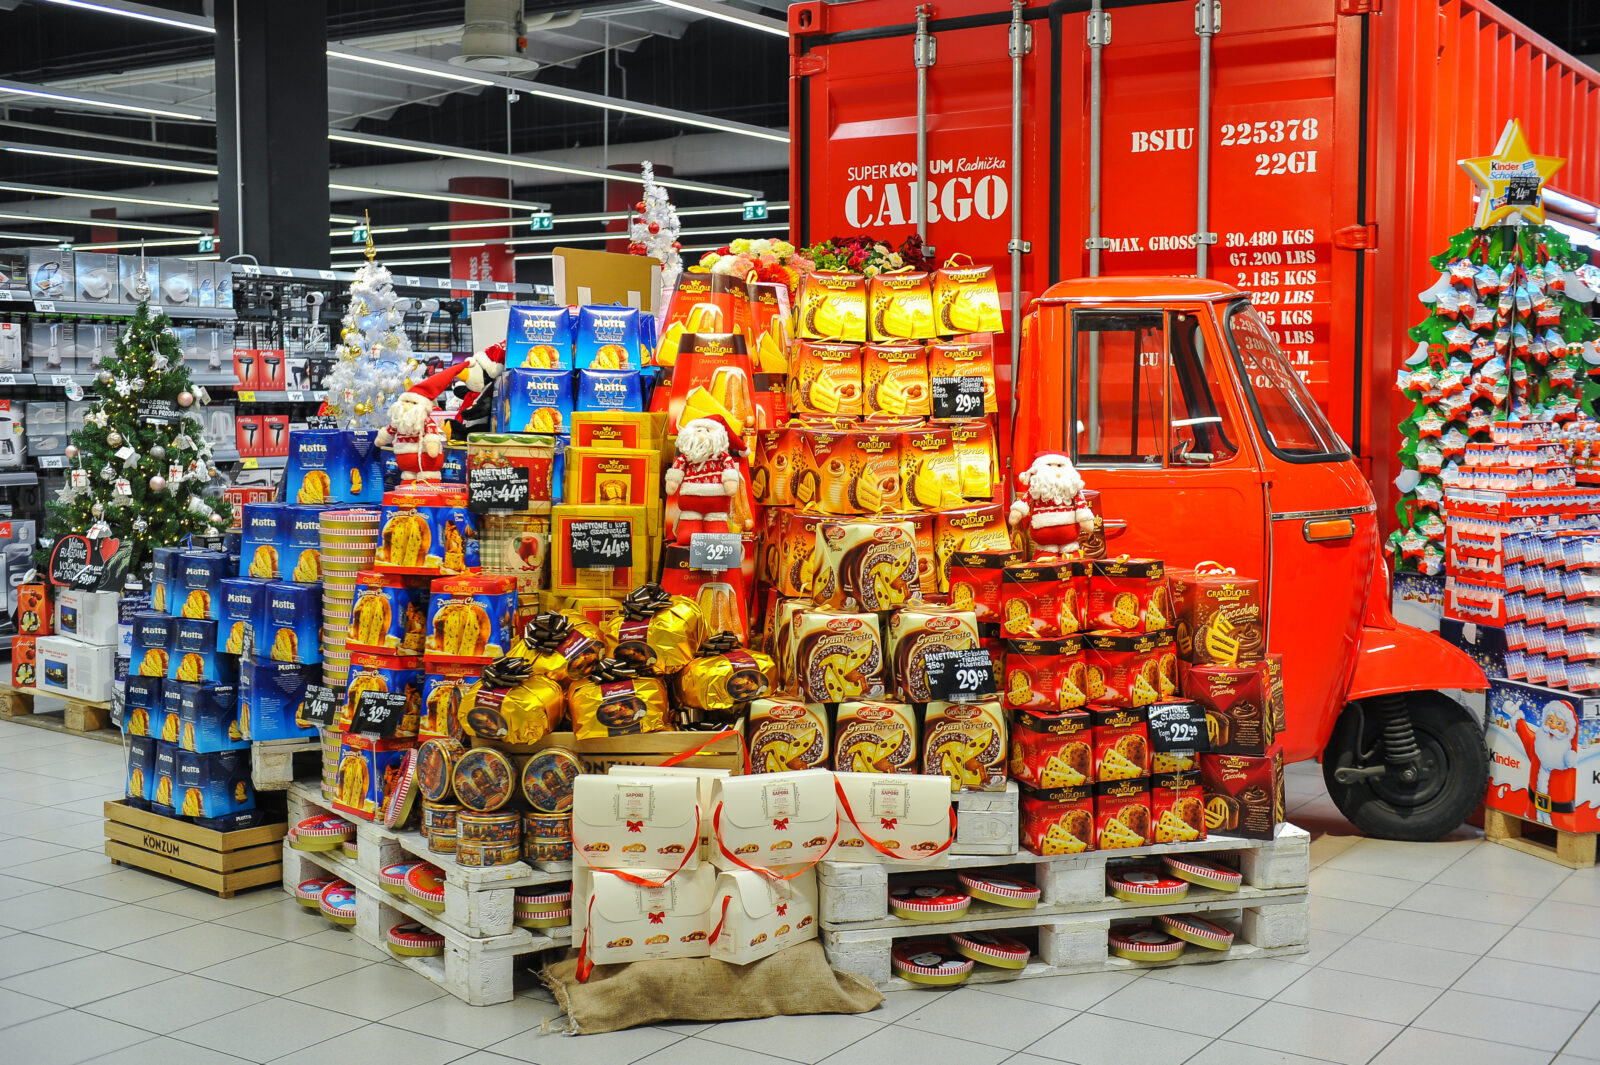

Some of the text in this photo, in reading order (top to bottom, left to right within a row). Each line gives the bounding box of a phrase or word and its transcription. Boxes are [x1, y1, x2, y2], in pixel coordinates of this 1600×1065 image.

[1131, 118, 1318, 152] BSIU 225378
[847, 165, 887, 181] SUPER
[956, 156, 1006, 172] Radnička
[845, 174, 1008, 229] CARGO
[1109, 229, 1314, 252] MAX. GROSS 30.480 KGS
[1229, 250, 1316, 266] 67.200 LBS
[1237, 270, 1316, 287] 2.185 KGS
[1283, 290, 1314, 304] LBS
[1281, 310, 1312, 325] KGS
[523, 319, 557, 329] Motta
[593, 319, 627, 329] Motta
[1285, 331, 1314, 344] LBS
[527, 381, 560, 391] Motta
[594, 382, 628, 392] Motta
[299, 443, 327, 454] Motta
[251, 517, 277, 528] Motta
[186, 567, 210, 577] Motta
[227, 594, 252, 604] Motta
[272, 599, 295, 610] Motta
[142, 626, 168, 636] Motta
[180, 630, 203, 640] Motta
[129, 685, 148, 695] Motta
[181, 765, 200, 774] Motta
